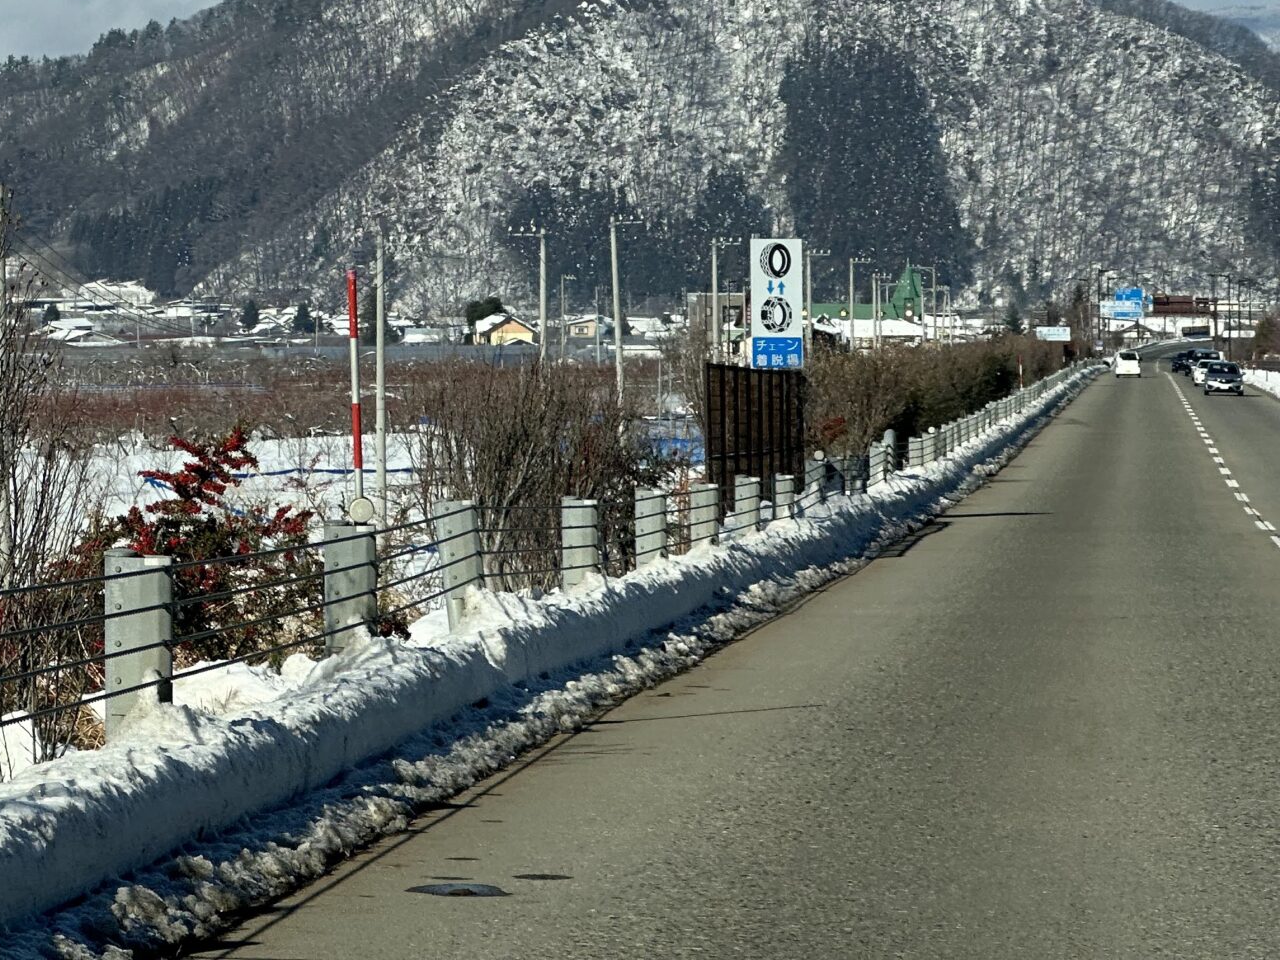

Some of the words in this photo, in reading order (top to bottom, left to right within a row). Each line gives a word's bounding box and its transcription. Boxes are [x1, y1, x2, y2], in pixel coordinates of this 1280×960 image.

[756, 339, 799, 351] チェーン
[756, 353, 799, 367] 着脱場
